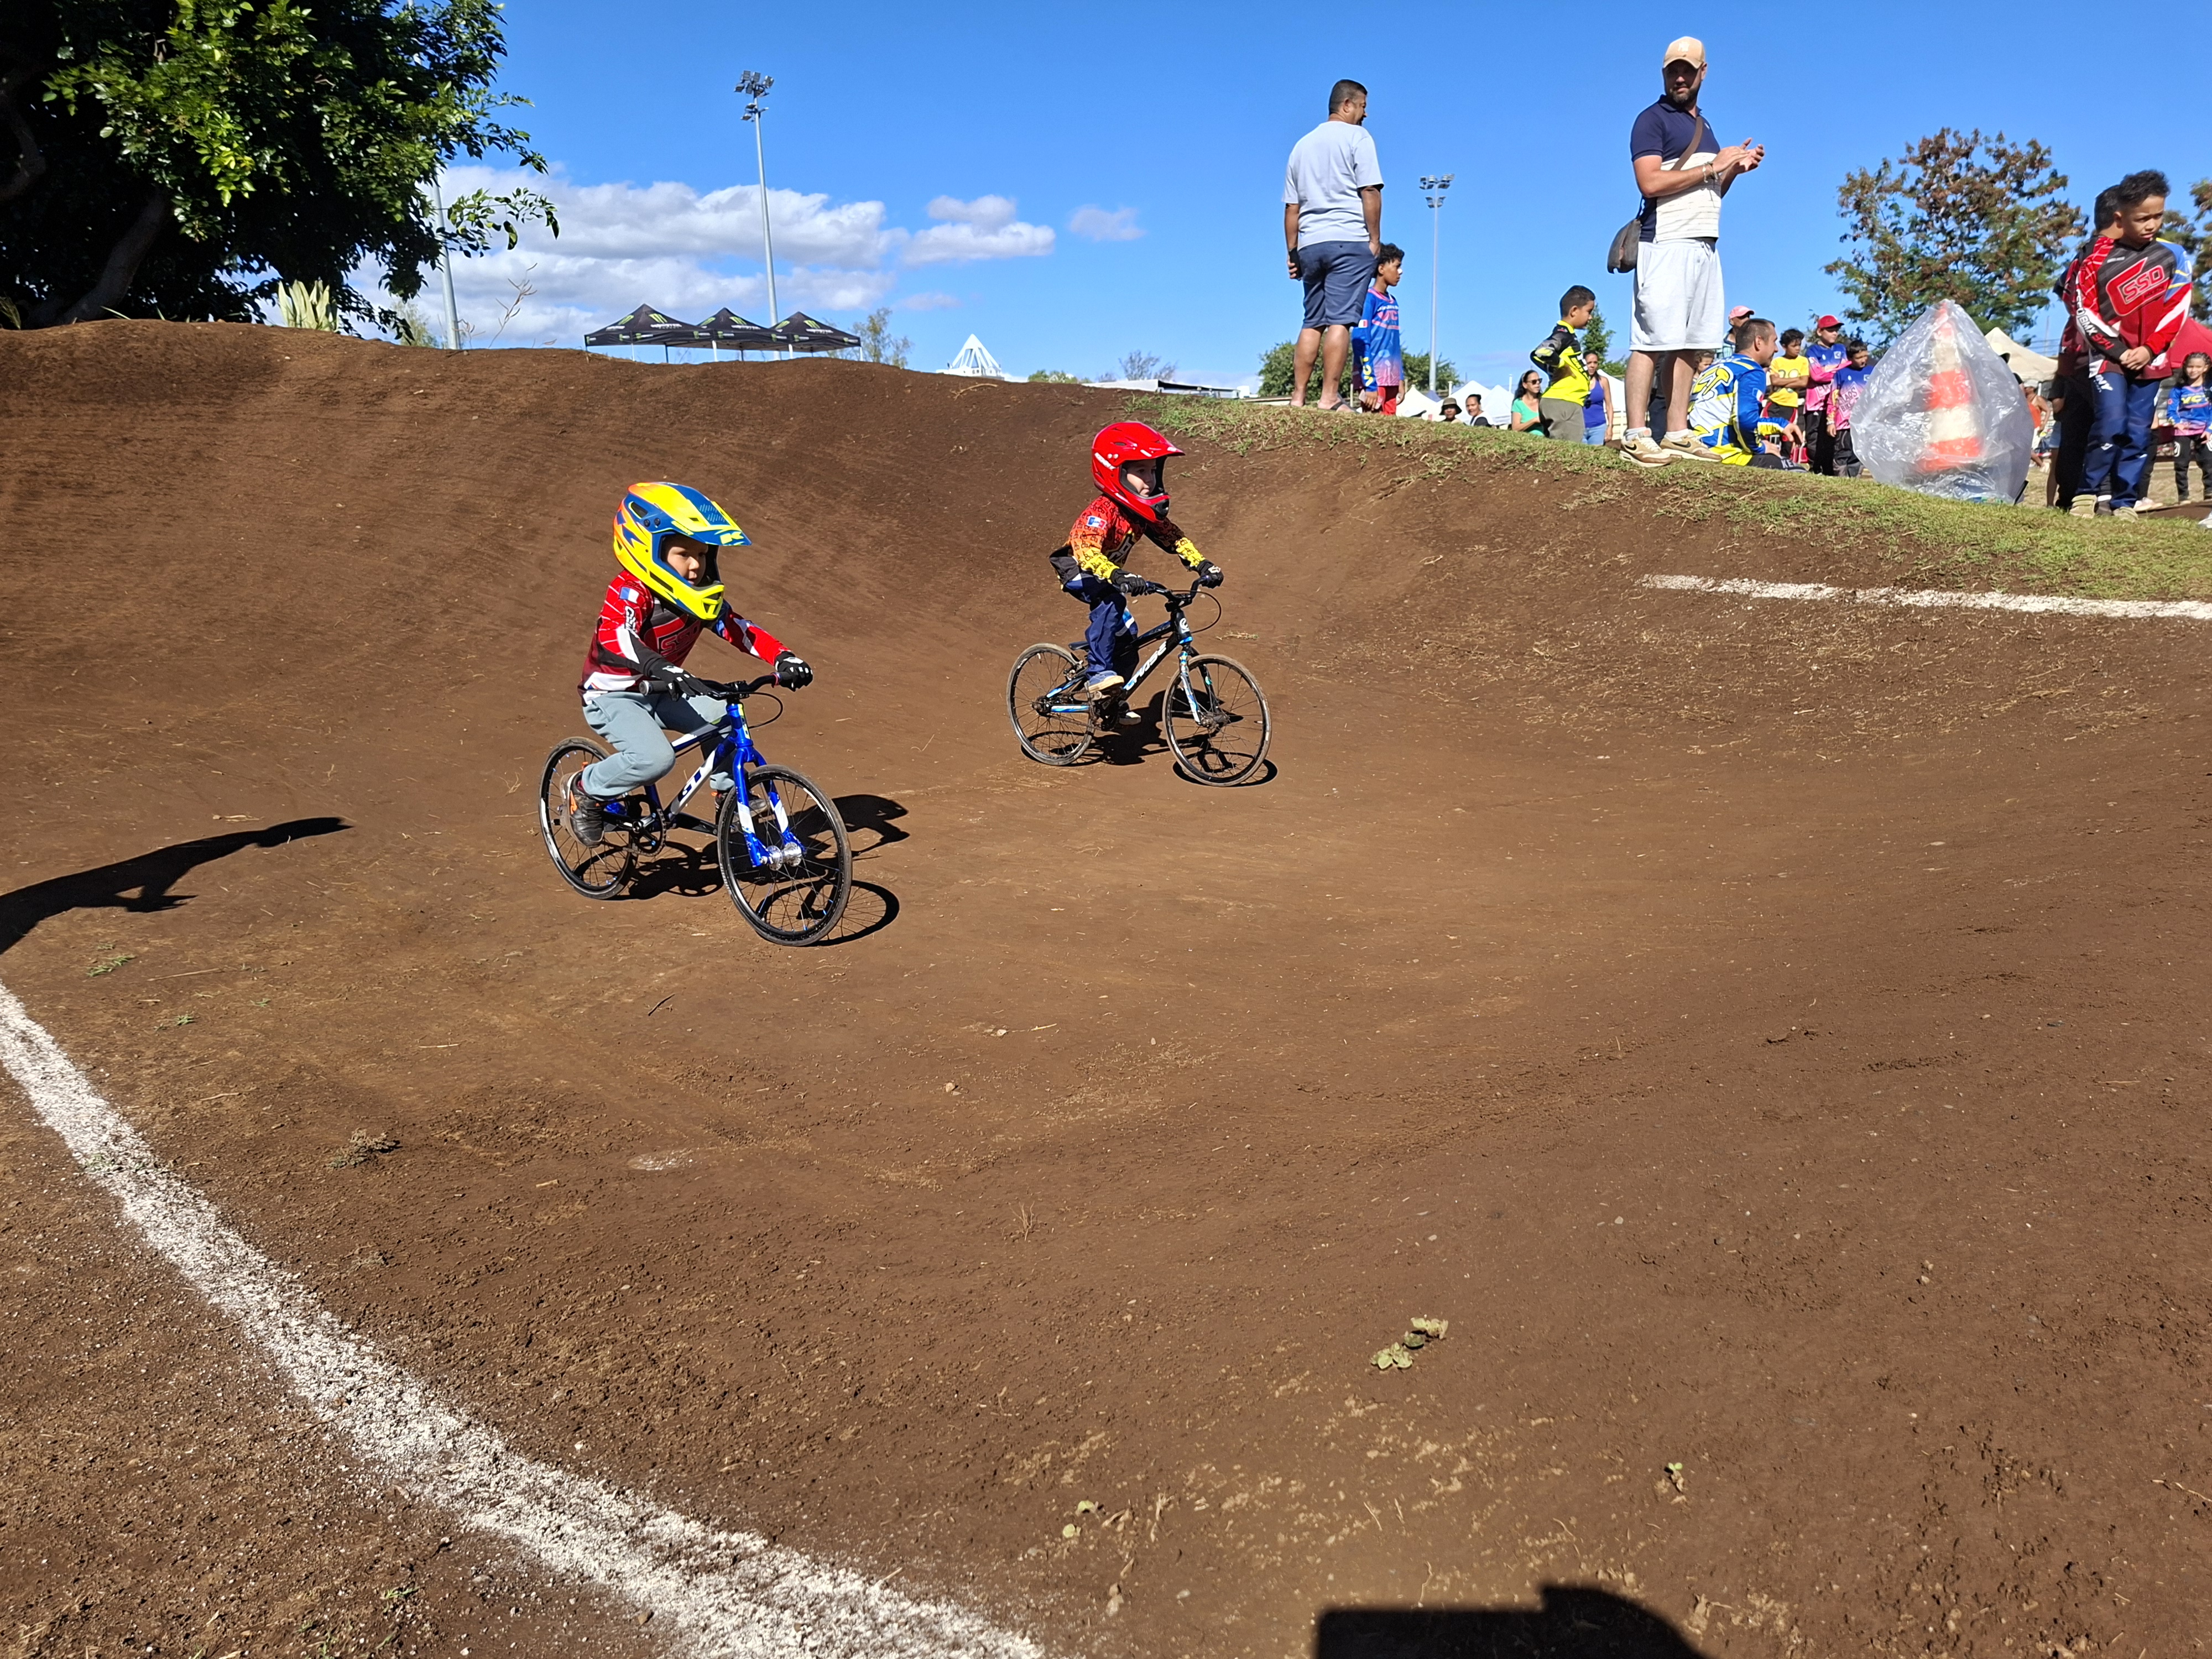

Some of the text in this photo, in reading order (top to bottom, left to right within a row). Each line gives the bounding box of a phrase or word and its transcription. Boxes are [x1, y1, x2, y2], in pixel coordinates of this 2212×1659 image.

[2122, 265, 2164, 304] SSD
[2078, 314, 2098, 336] BMX
[2091, 333, 2115, 351] 974
[1123, 641, 1167, 691] CHASE
